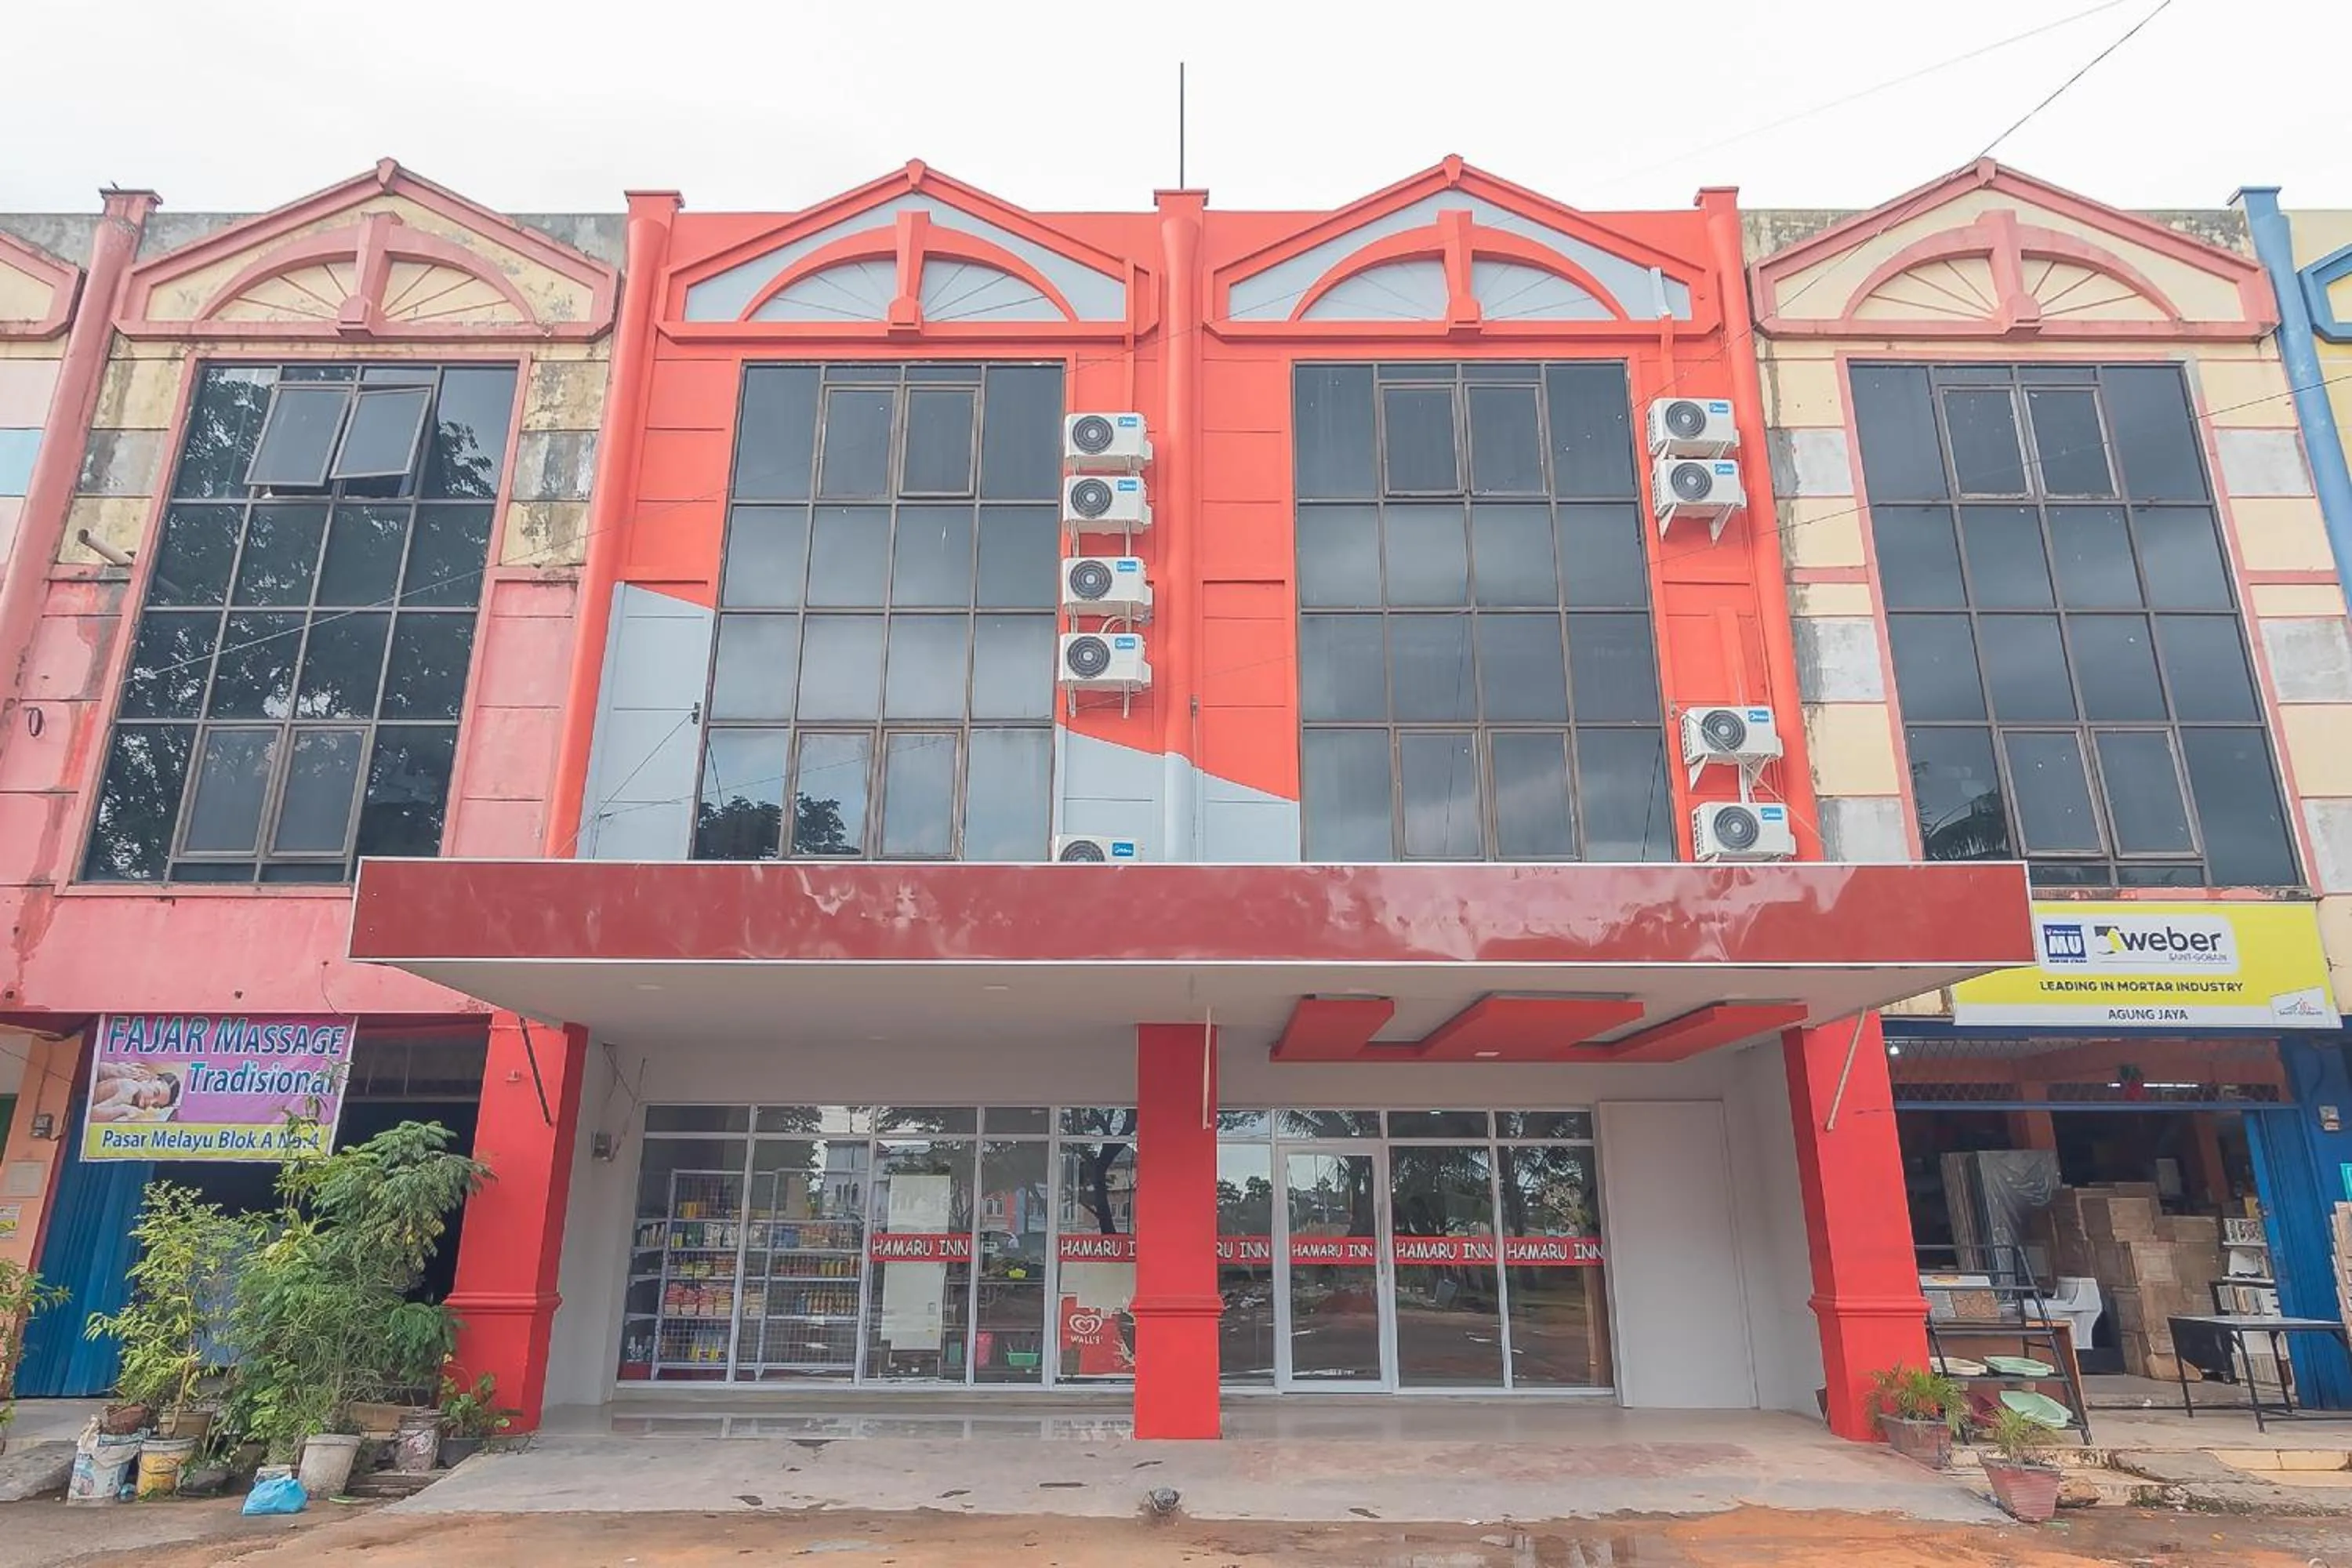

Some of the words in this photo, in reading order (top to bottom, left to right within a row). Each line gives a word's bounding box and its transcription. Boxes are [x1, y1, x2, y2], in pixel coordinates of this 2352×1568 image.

[2049, 935, 2082, 954] MU
[2120, 926, 2223, 951] weber
[2040, 981, 2098, 992] LEADING
[2101, 981, 2115, 992] IN
[2118, 981, 2173, 992] MORTAR
[2176, 982, 2244, 992] INDUSTRY
[2108, 1009, 2155, 1020] AGUNG
[2158, 1009, 2188, 1020] JAYA
[107, 1016, 209, 1054] FAJAR
[212, 1017, 346, 1056] MASSAGE
[102, 1130, 147, 1149] Pasar
[151, 1131, 212, 1152] Melayu
[218, 1131, 256, 1149] Blok
[260, 1131, 273, 1149] A
[873, 1239, 932, 1256] HAMARU
[938, 1239, 969, 1256] INN
[1061, 1239, 1121, 1256] HAMARU
[1240, 1242, 1269, 1258] INN
[1292, 1242, 1343, 1258] HAMARU
[1348, 1243, 1373, 1258] INN
[1396, 1240, 1457, 1259] HAMARU
[1463, 1242, 1493, 1259] INN
[1507, 1241, 1567, 1260] HAMARU
[1573, 1242, 1604, 1260] INN
[1070, 1335, 1100, 1345] WALL'S
